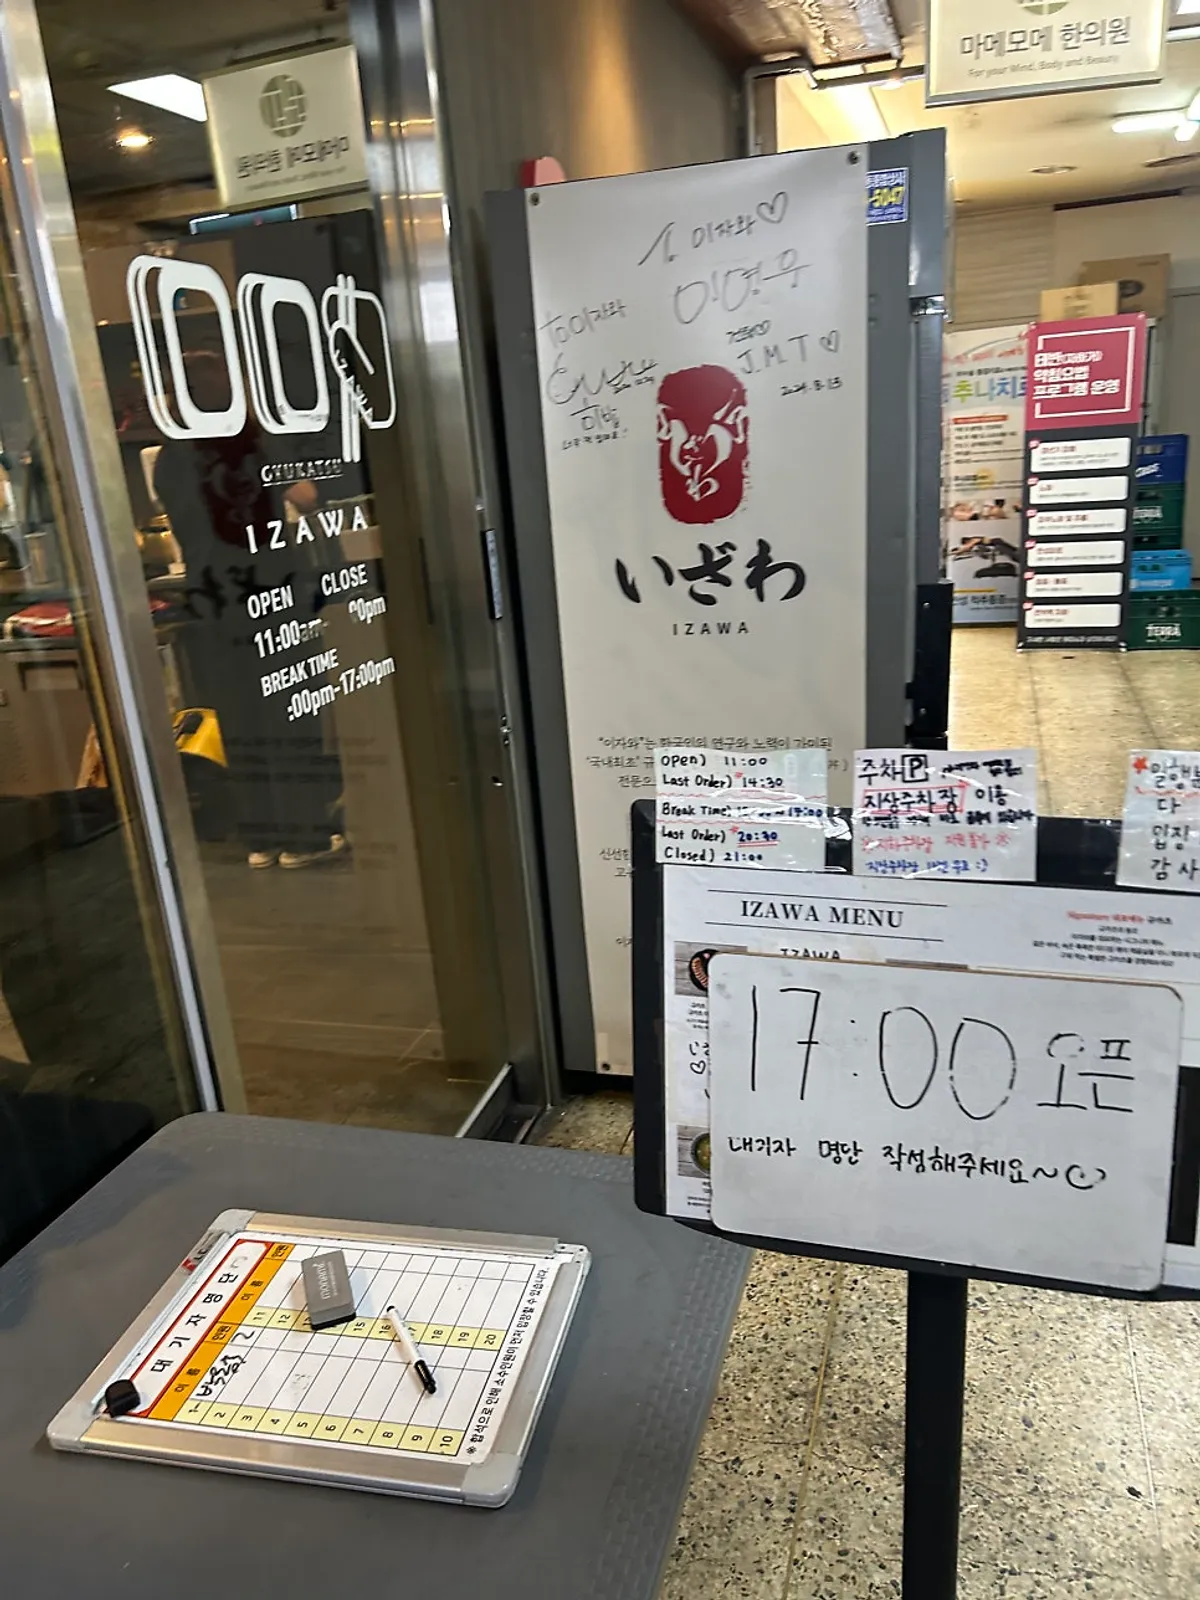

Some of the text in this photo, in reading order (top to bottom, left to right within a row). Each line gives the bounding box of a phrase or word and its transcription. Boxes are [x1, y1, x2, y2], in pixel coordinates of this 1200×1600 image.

[1060, 16, 1131, 51] 한의원
[245, 505, 369, 554] IZAWA
[615, 538, 806, 606] いざわ
[247, 563, 369, 619] OPEN CLOSE
[673, 622, 749, 636] IZAWA
[260, 648, 339, 697] BREAK TIME
[724, 755, 769, 767] 11:00
[858, 758, 901, 786] 주차
[663, 774, 690, 788] Last
[742, 776, 784, 789] 14:30
[975, 784, 1008, 806] 이용
[661, 802, 696, 816] Break
[661, 825, 685, 840] Last
[737, 830, 779, 842] 20:30
[664, 846, 763, 862] Closed) 21:00
[741, 900, 904, 928] IZAWA MENU
[751, 983, 1135, 1120] 17:00 오픈
[818, 1139, 864, 1165] 명단
[253, 1311, 266, 1321] 11
[353, 1321, 366, 1332] 15
[214, 1314, 291, 1420] 2 12
[325, 1323, 392, 1433] 6 16
[382, 1328, 444, 1439] 8 18
[412, 1331, 470, 1442] 9 19
[440, 1334, 497, 1447] 10 20
[270, 1417, 281, 1426] 4
[470, 1407, 494, 1443] 합석으로
[485, 1388, 502, 1405] 인해
